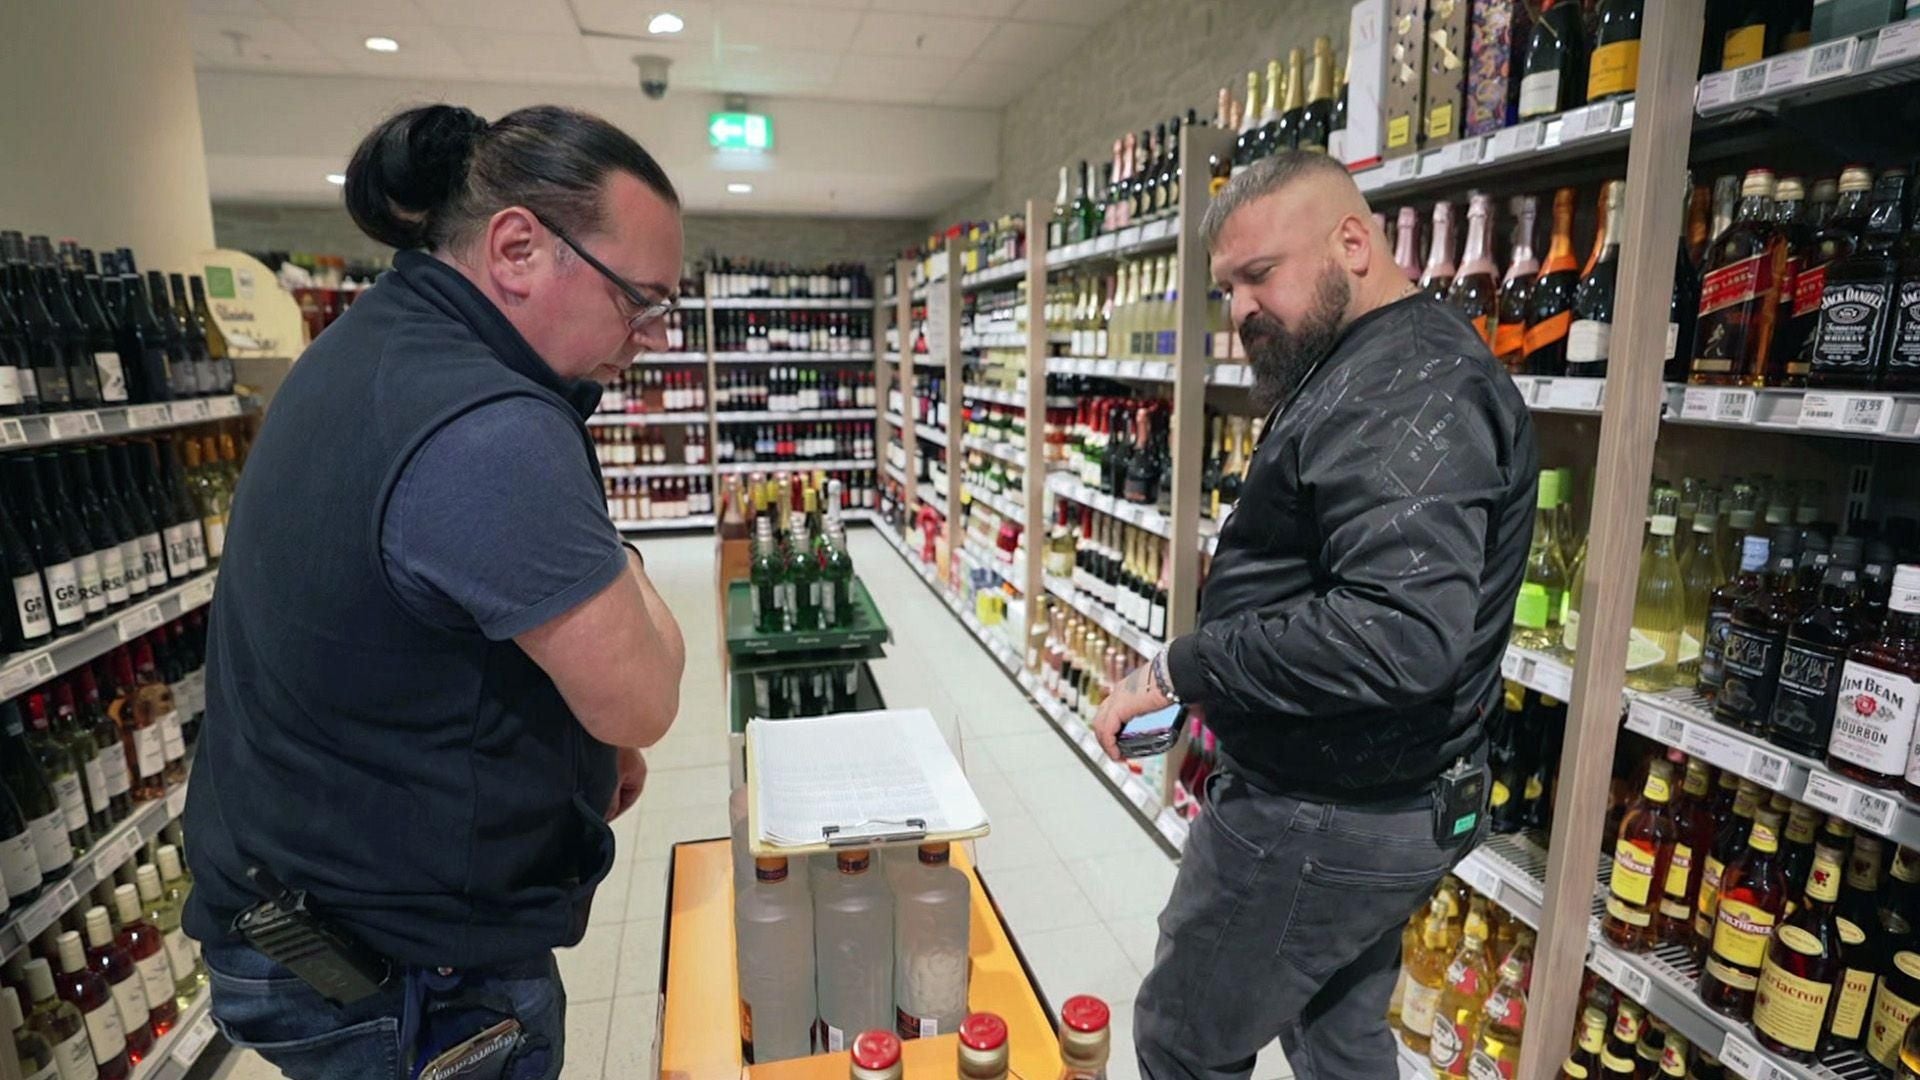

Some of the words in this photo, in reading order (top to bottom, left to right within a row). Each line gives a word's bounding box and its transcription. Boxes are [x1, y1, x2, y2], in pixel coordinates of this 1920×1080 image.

[1721, 271, 1755, 288] LABEL
[1820, 292, 1844, 310] JACK
[1854, 399, 1883, 411] 19.99
[1840, 675, 1863, 692] JIM
[1864, 677, 1904, 711] BEAM
[1835, 720, 1888, 745] BOURBON
[1860, 795, 1887, 812] 15.99
[1719, 910, 1773, 935] WILTHENER
